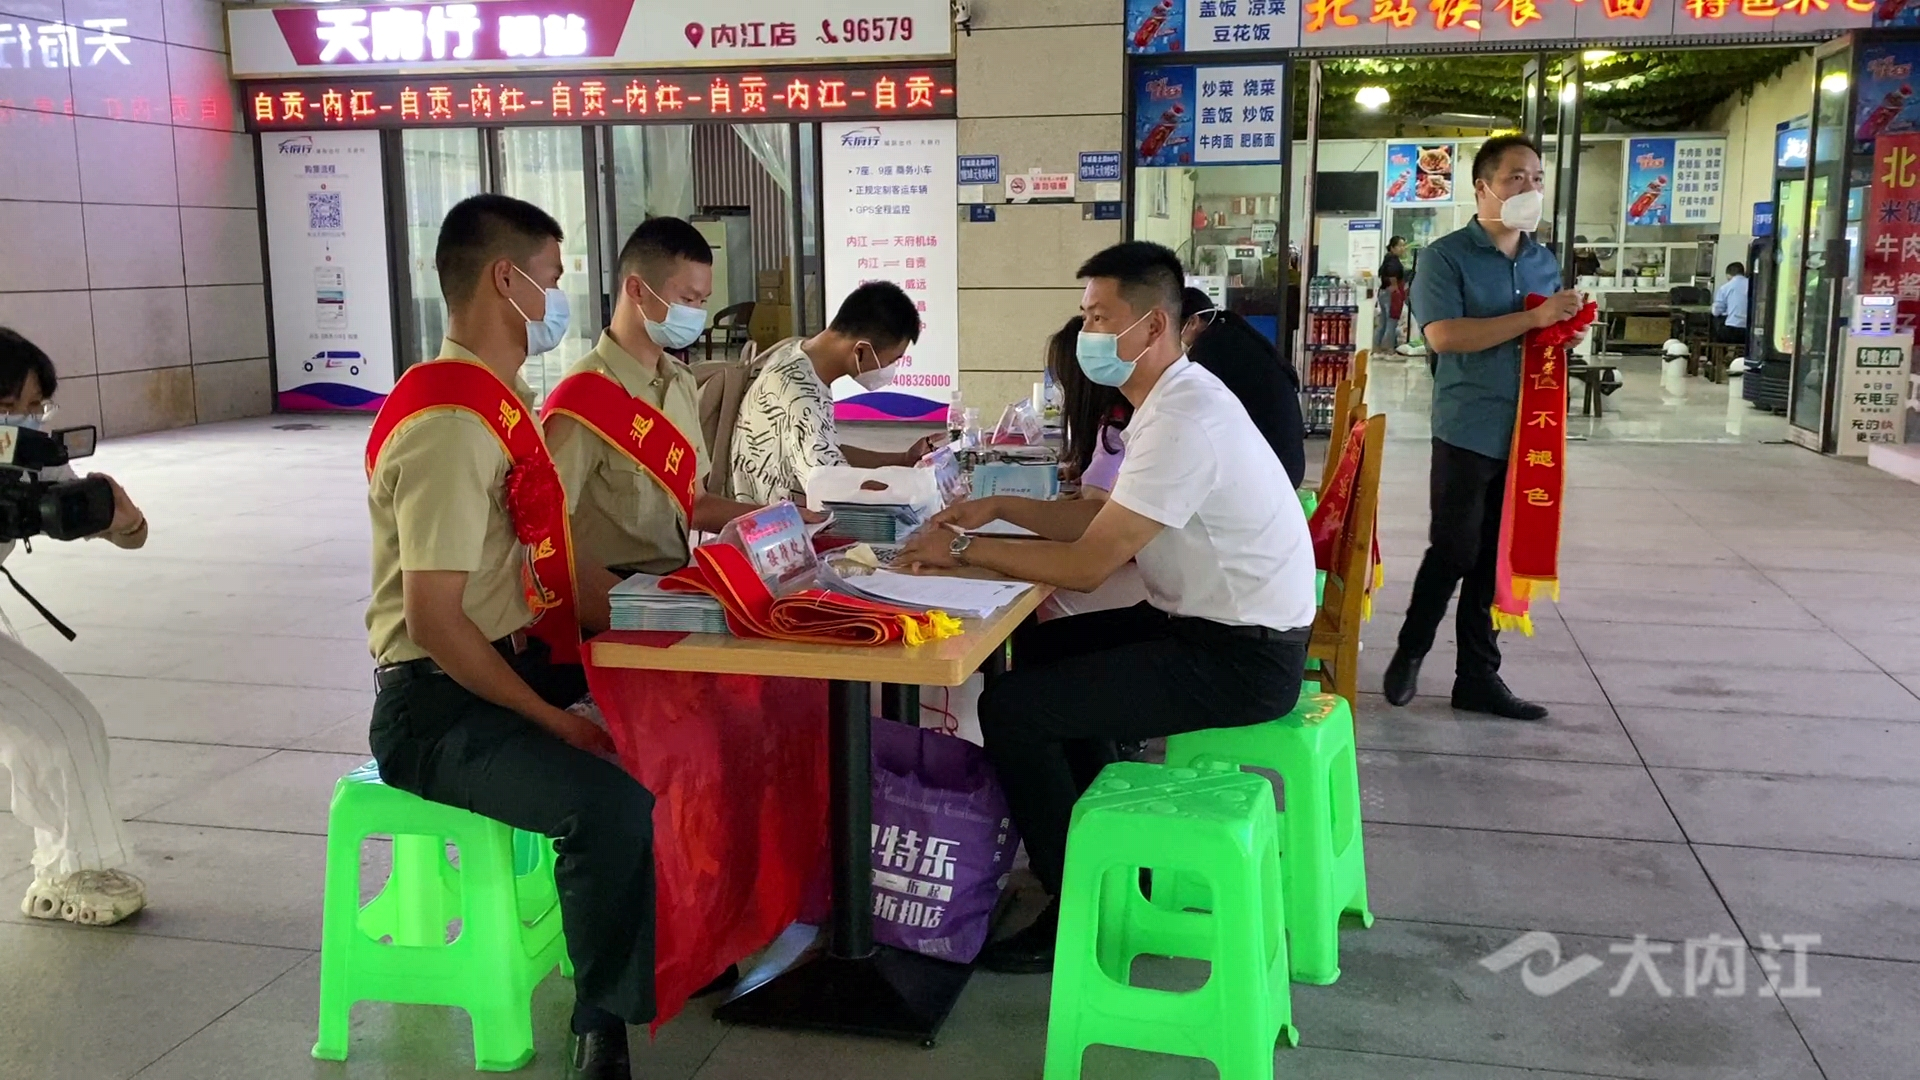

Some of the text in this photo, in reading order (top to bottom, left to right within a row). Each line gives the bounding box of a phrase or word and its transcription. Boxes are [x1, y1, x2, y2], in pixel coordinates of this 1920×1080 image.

[1199, 0, 1236, 18] 盖饭
[711, 22, 796, 48] 内江店
[843, 16, 913, 42] 96579
[1213, 23, 1271, 43] 豆花饭
[1202, 79, 1234, 97] 炒菜
[1243, 79, 1276, 96] 烧菜
[1201, 105, 1275, 124] 盖饭 炒饭
[841, 136, 880, 147] 天府行
[1199, 132, 1276, 149] 牛肉面 肥肠面
[896, 165, 932, 175] 商务小车
[1881, 146, 1917, 189] 北
[855, 185, 928, 195] 正规定制客运车辆
[855, 205, 911, 214] GPS全程监控
[846, 236, 938, 247] 内江 天府机场
[857, 257, 926, 269] 内江 自贡
[905, 279, 927, 290] 威远
[886, 374, 951, 387] 408326000
[1853, 392, 1899, 406] 充电宝
[1851, 419, 1895, 431] 充的快
[871, 823, 961, 881] 特乐
[871, 869, 942, 899] 一折起
[872, 892, 946, 929] 折扣店
